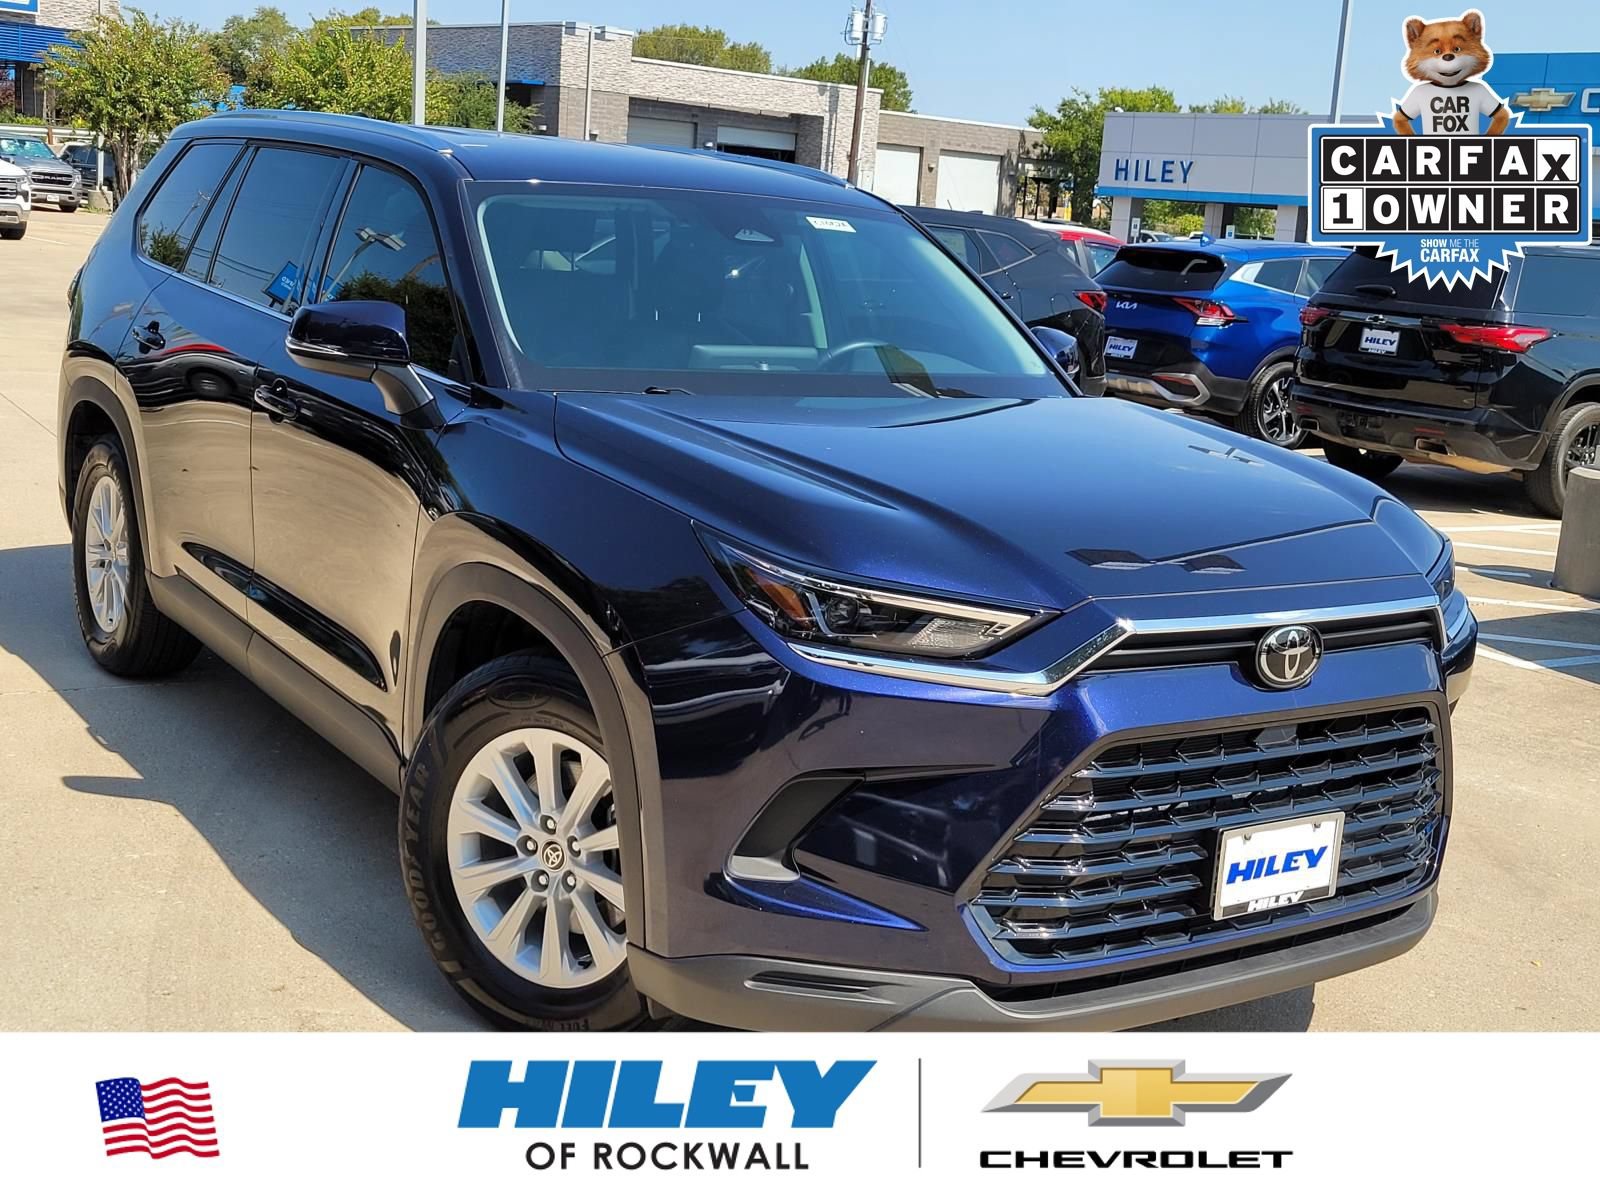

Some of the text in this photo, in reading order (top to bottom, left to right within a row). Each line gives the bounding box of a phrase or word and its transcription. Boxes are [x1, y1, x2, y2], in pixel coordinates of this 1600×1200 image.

[1114, 158, 1194, 184] HILEY
[1109, 343, 1134, 352] HILEY
[1364, 336, 1396, 346] HILEY
[404, 762, 446, 951] GOODYEAR
[1226, 845, 1329, 885] HILEY
[1247, 890, 1305, 912] HILEY
